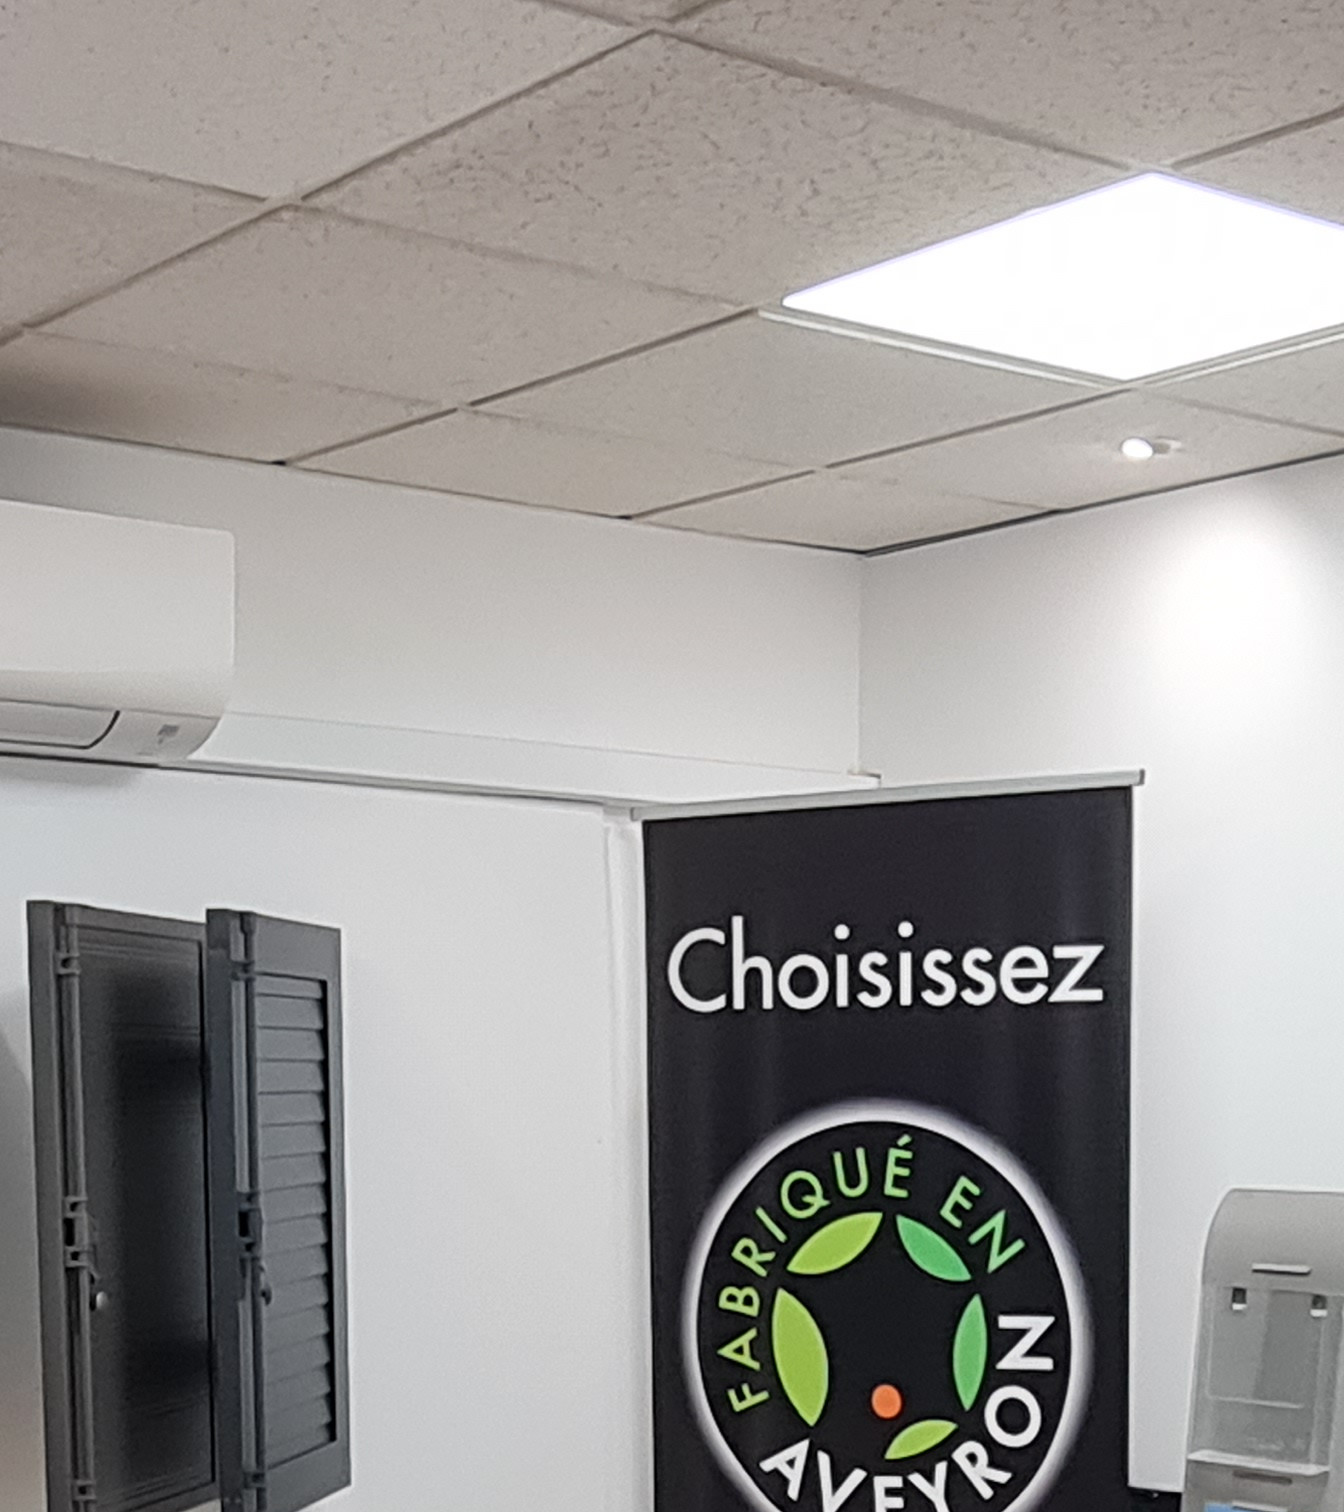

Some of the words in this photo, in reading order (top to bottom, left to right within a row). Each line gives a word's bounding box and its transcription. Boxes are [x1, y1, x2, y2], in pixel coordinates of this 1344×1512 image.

[667, 915, 1105, 1013] Choisissez
[717, 1135, 913, 1412] FABRIQUÉ
[940, 1176, 1025, 1273] EN
